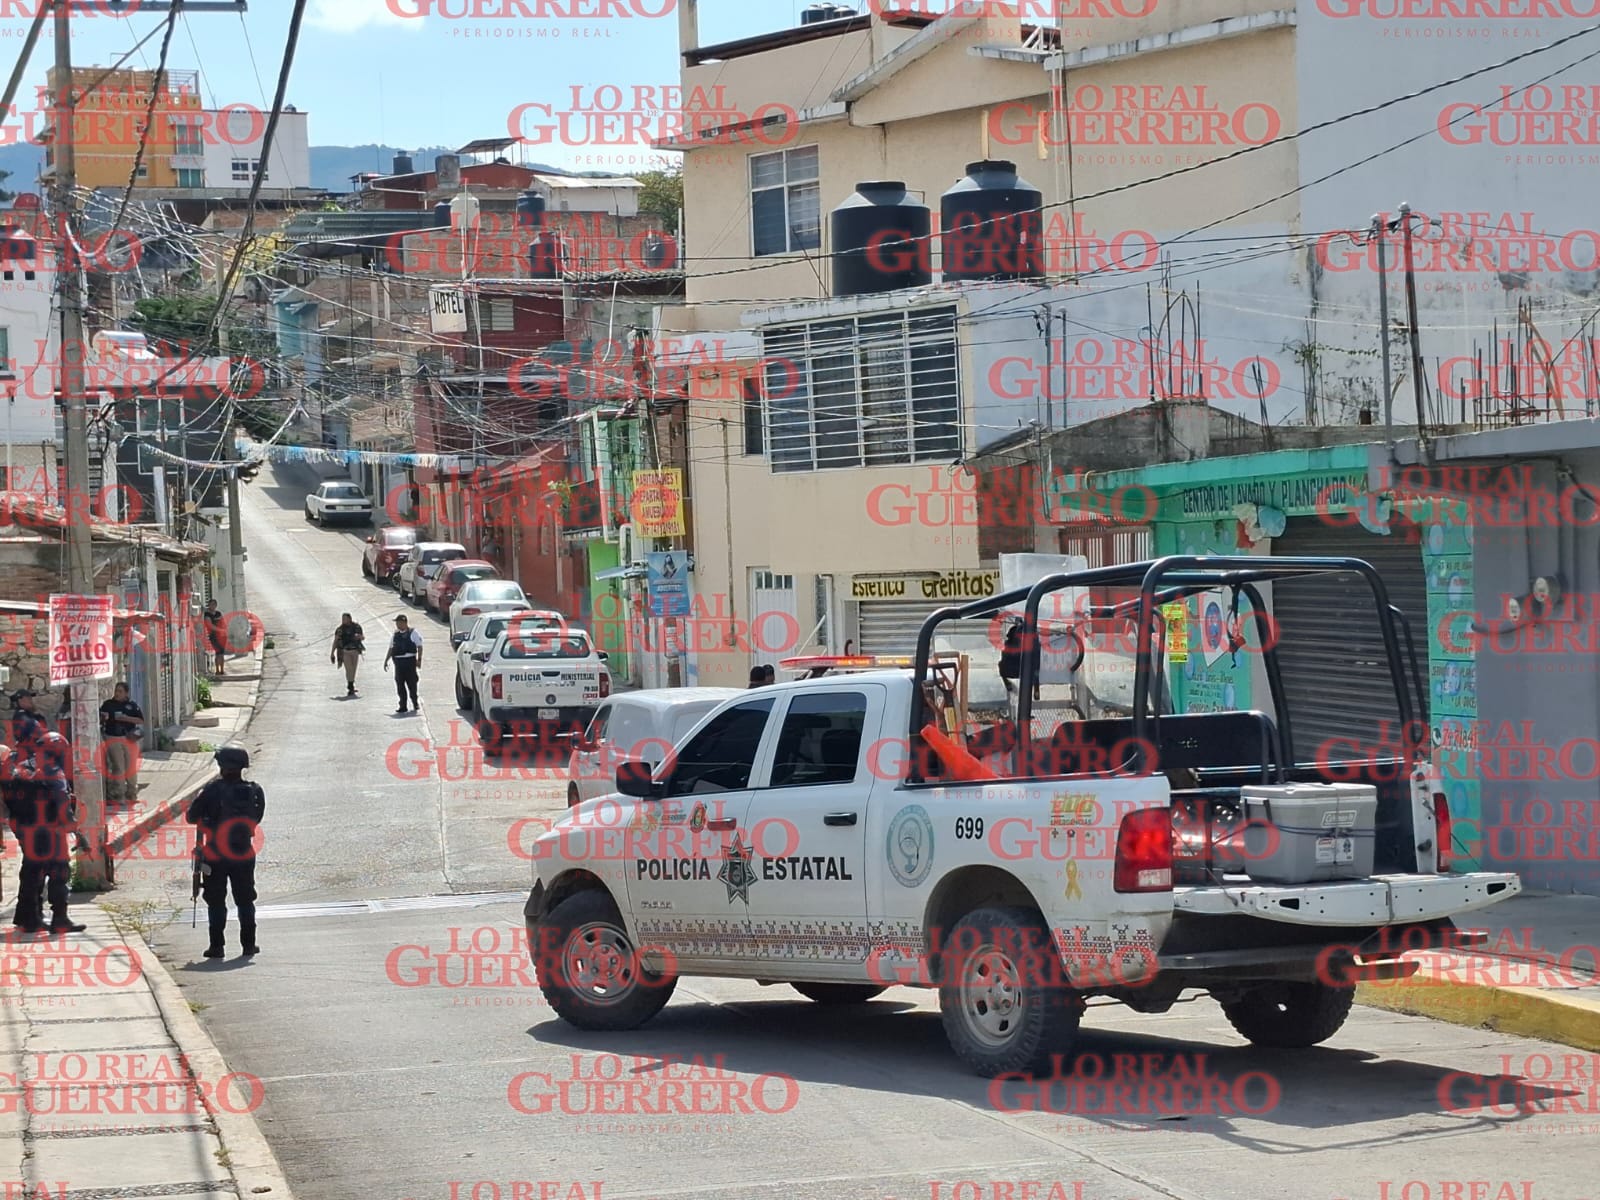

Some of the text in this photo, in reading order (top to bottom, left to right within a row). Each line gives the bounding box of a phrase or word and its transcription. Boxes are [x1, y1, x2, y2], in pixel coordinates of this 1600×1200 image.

[434, 291, 463, 314] HOTEL
[1183, 486, 1216, 513] CENTRO
[1218, 484, 1229, 511] DE
[1281, 476, 1346, 508] PLANCHADO
[53, 639, 108, 663] auto
[560, 672, 596, 682] MINISTERIAL
[955, 817, 984, 840] 699
[637, 852, 852, 881] POLICÍA ESTATAL
